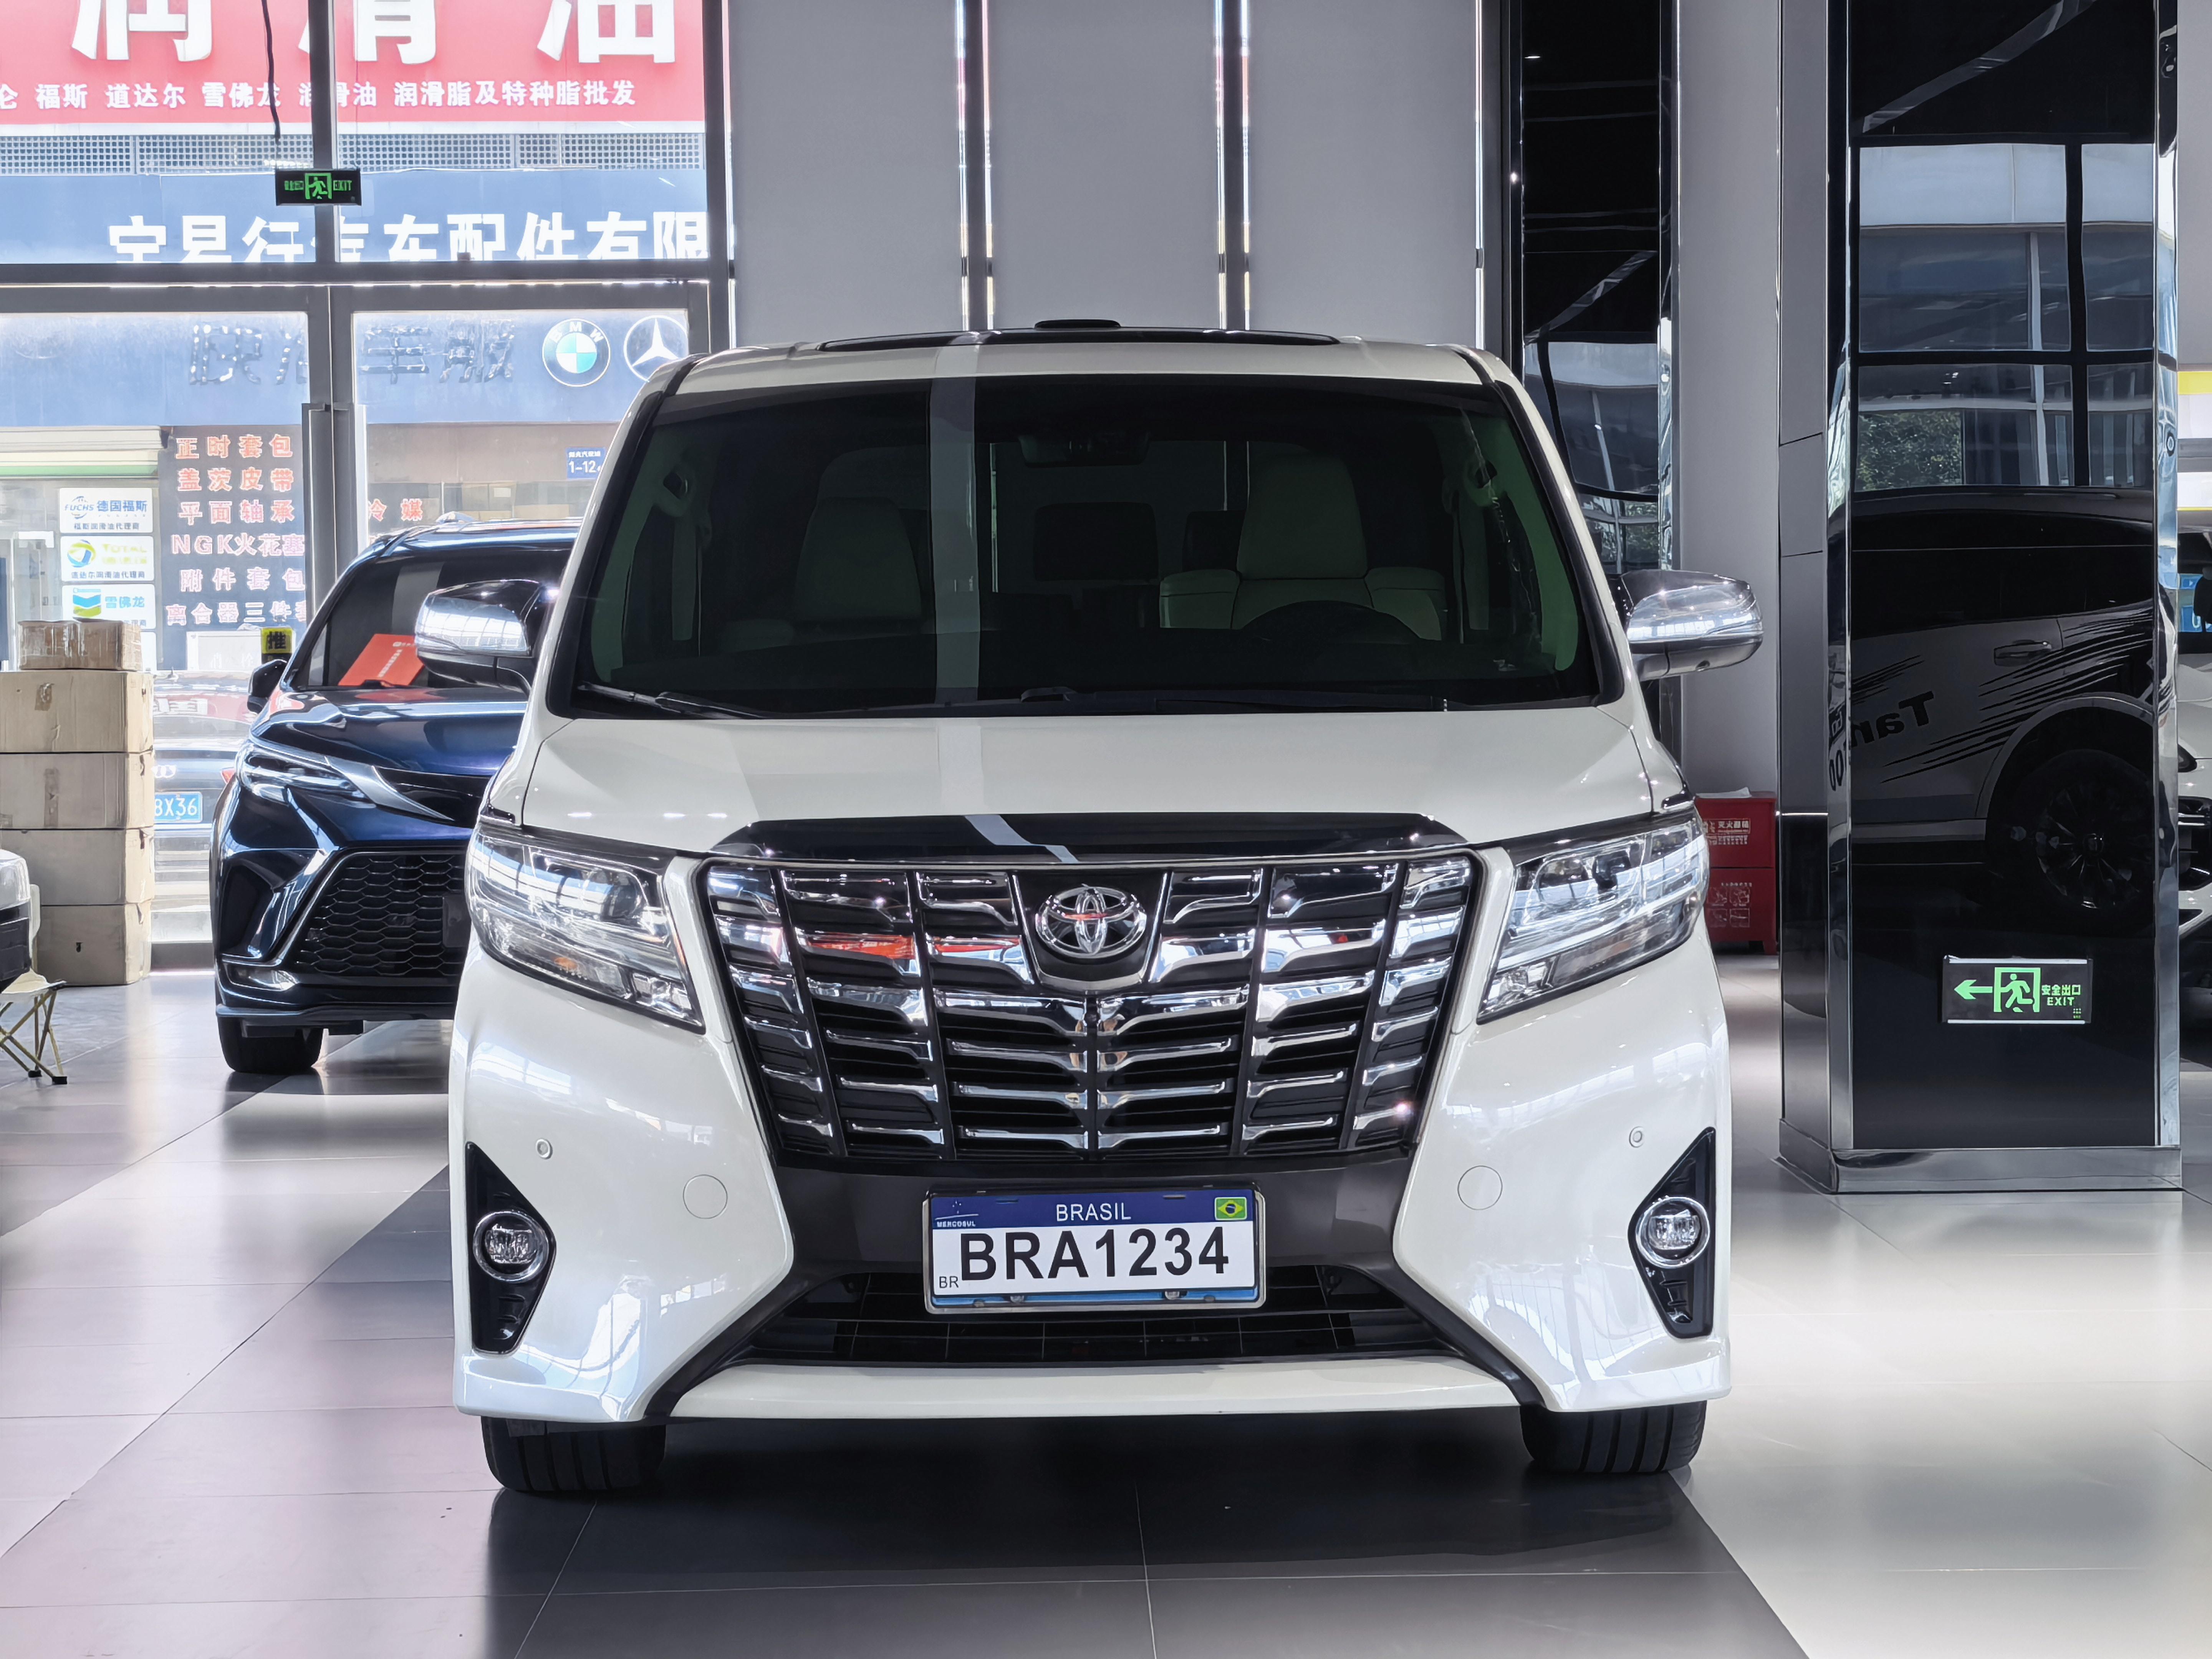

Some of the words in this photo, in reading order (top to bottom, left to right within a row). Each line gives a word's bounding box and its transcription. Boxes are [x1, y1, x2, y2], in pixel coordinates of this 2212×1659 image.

[36, 83, 88, 109] 福斯
[106, 83, 186, 109] 道达尔
[202, 82, 281, 108] 雪佛龙
[394, 79, 636, 107] 润滑脂及特种脂批发
[176, 434, 293, 459] 正时套包
[177, 467, 294, 492] 盖茨皮带
[97, 500, 147, 512] 德国福斯
[178, 499, 295, 526] 平面轴承
[180, 566, 306, 592] 附件套包
[105, 596, 145, 608] 雪佛龙
[267, 631, 287, 649] 推
[2041, 985, 2081, 995] 安全出口
[2047, 997, 2075, 1006] EXIT
[1056, 1202, 1131, 1222] BRASIL
[960, 1226, 1229, 1281] BRA1234
[939, 1276, 959, 1289] BR
